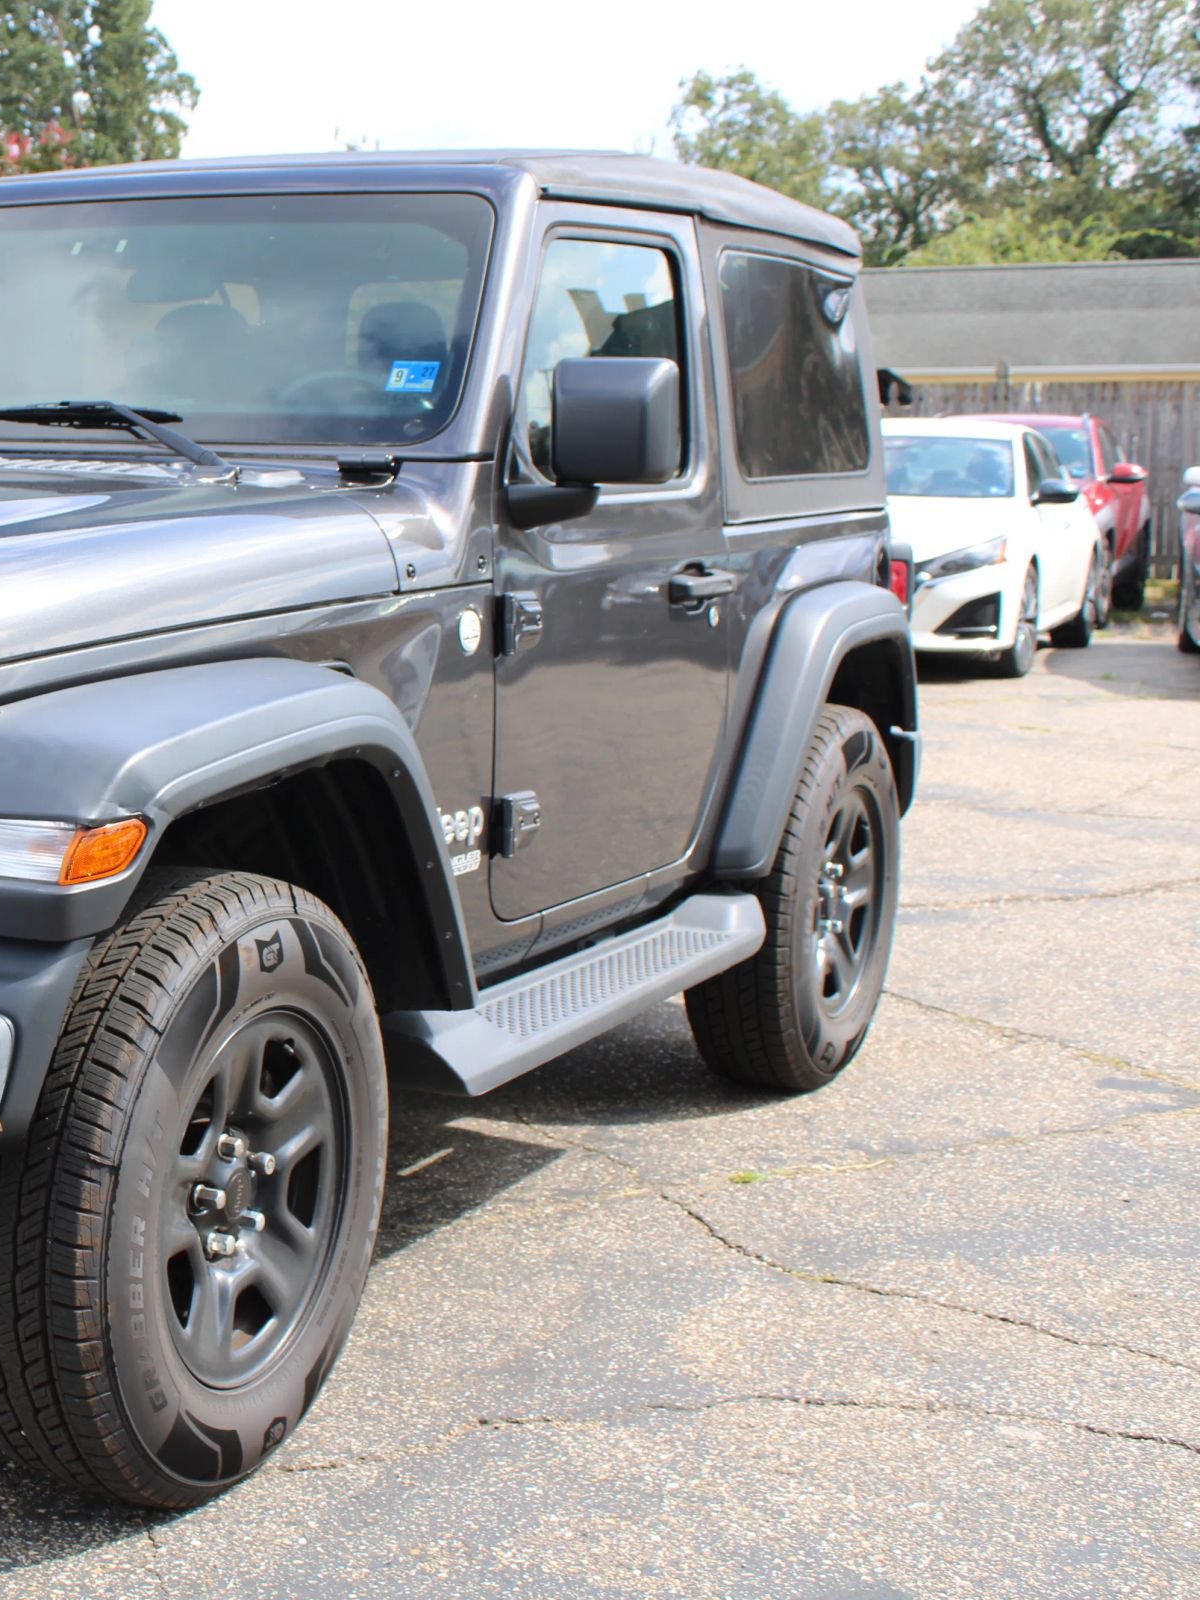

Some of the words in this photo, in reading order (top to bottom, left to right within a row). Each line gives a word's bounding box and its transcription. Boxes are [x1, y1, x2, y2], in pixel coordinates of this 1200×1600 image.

[394, 369, 405, 383] 9
[421, 366, 436, 378] 27
[436, 806, 484, 846] eep
[129, 1214, 168, 1413] GRABBER
